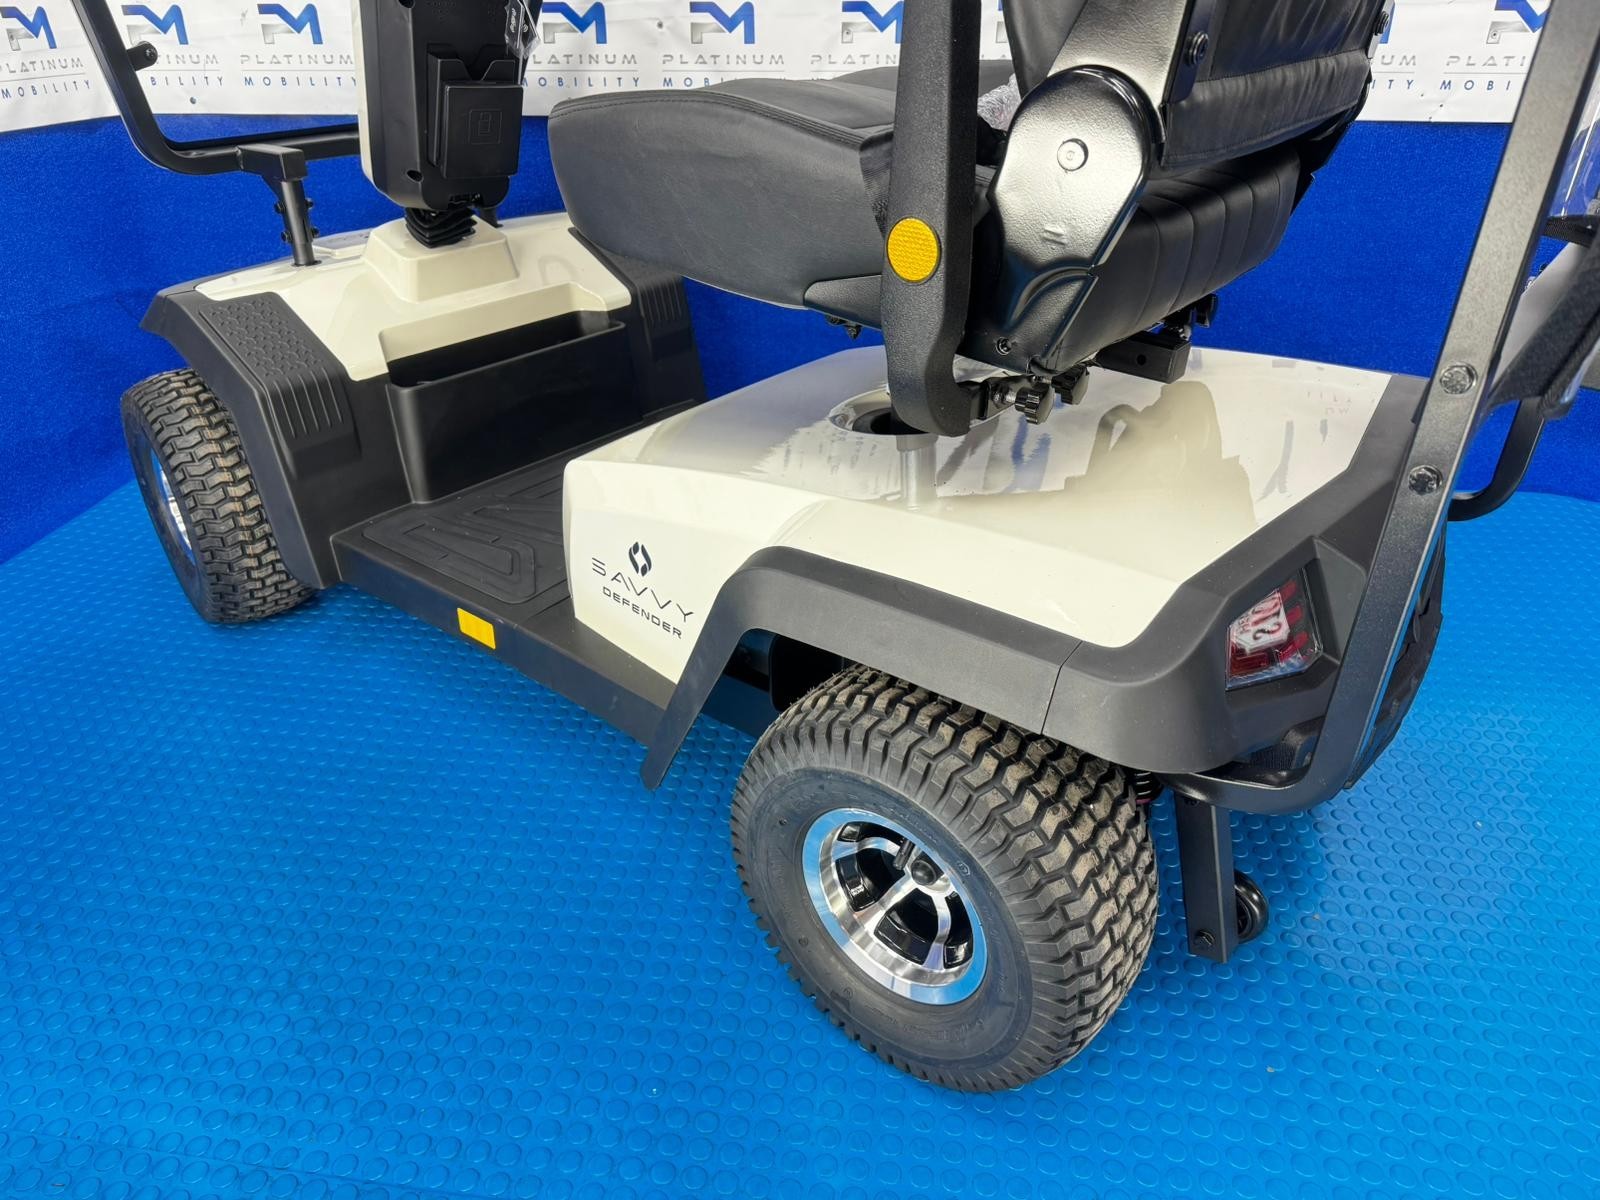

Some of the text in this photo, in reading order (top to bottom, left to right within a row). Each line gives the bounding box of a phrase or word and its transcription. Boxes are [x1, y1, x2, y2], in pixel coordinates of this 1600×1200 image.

[157, 54, 219, 64] INUM
[240, 54, 353, 64] PLATINUM
[533, 54, 638, 64] LATINUM
[662, 54, 785, 64] PLATINUM
[810, 54, 897, 65] PLATIN
[1446, 55, 1527, 66] PLATI
[0, 57, 83, 73] LATINUM
[150, 76, 223, 86] BILITY
[244, 76, 357, 87] MOBILITY
[1440, 80, 1511, 90] MOBI
[1, 79, 91, 99] MOBILITY
[591, 557, 695, 623] SAVVY
[602, 586, 683, 640] DEFENDER
